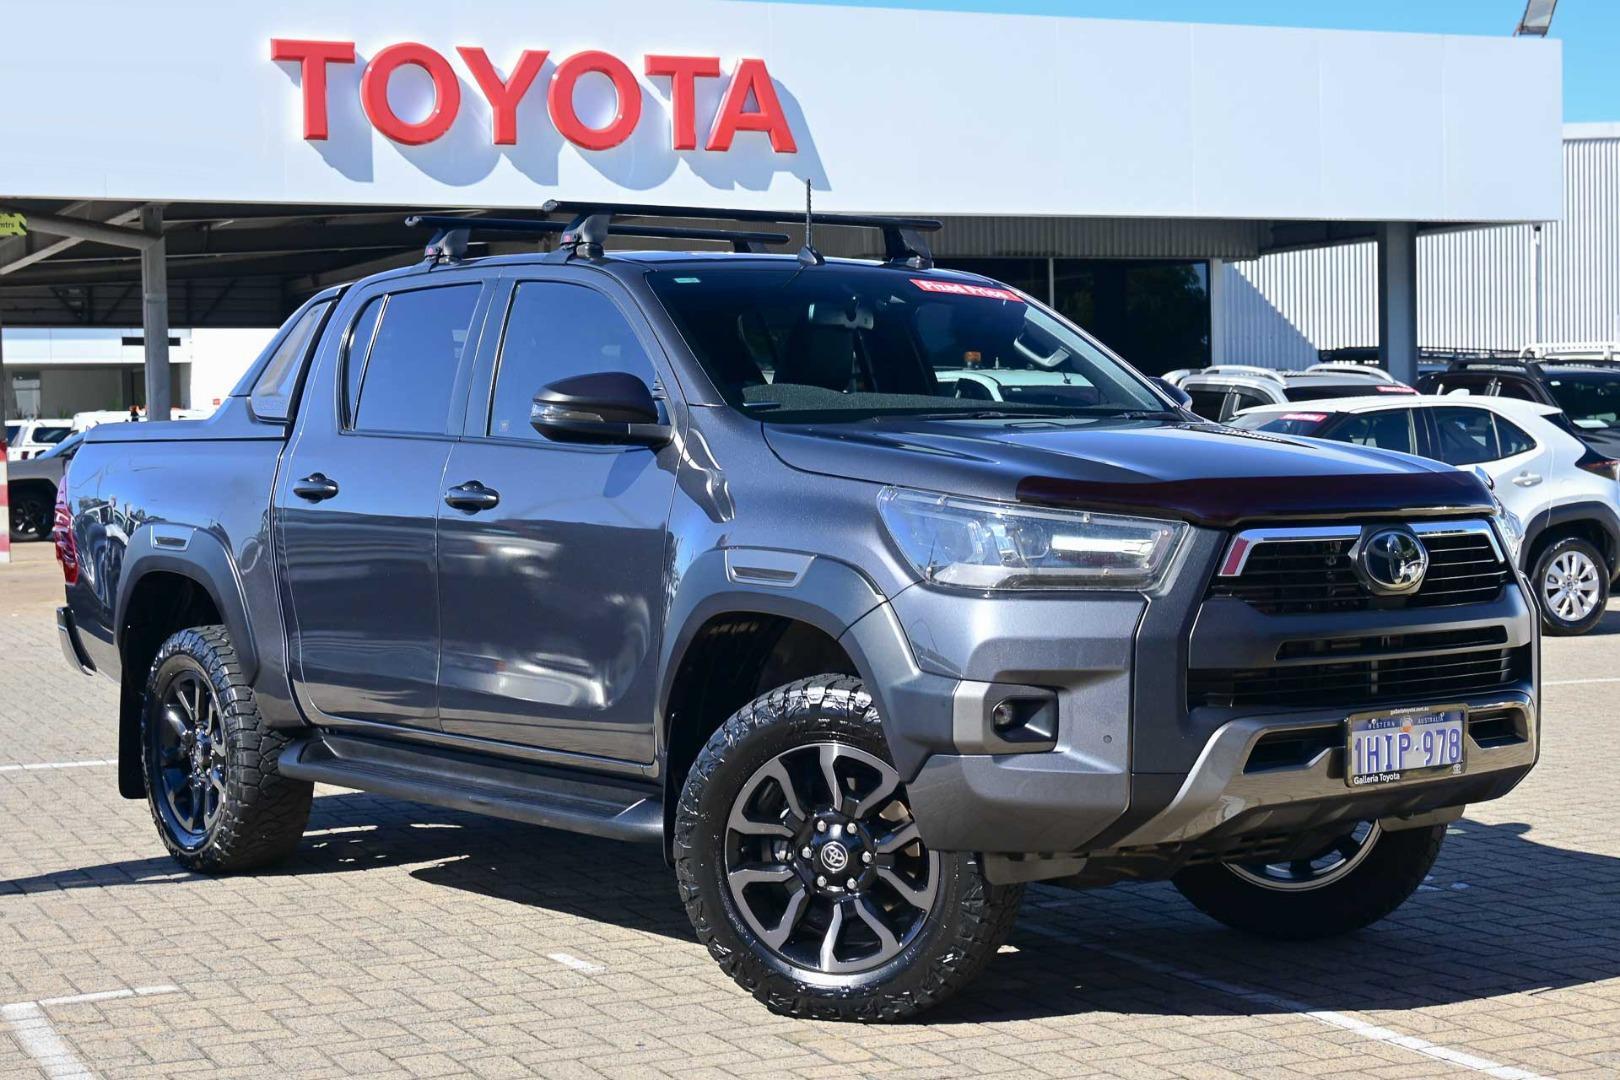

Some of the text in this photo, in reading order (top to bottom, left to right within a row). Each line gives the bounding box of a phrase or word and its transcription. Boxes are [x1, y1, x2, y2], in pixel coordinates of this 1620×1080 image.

[271, 38, 797, 153] TOYOTA
[1353, 772, 1401, 785] Galleria Toyota
